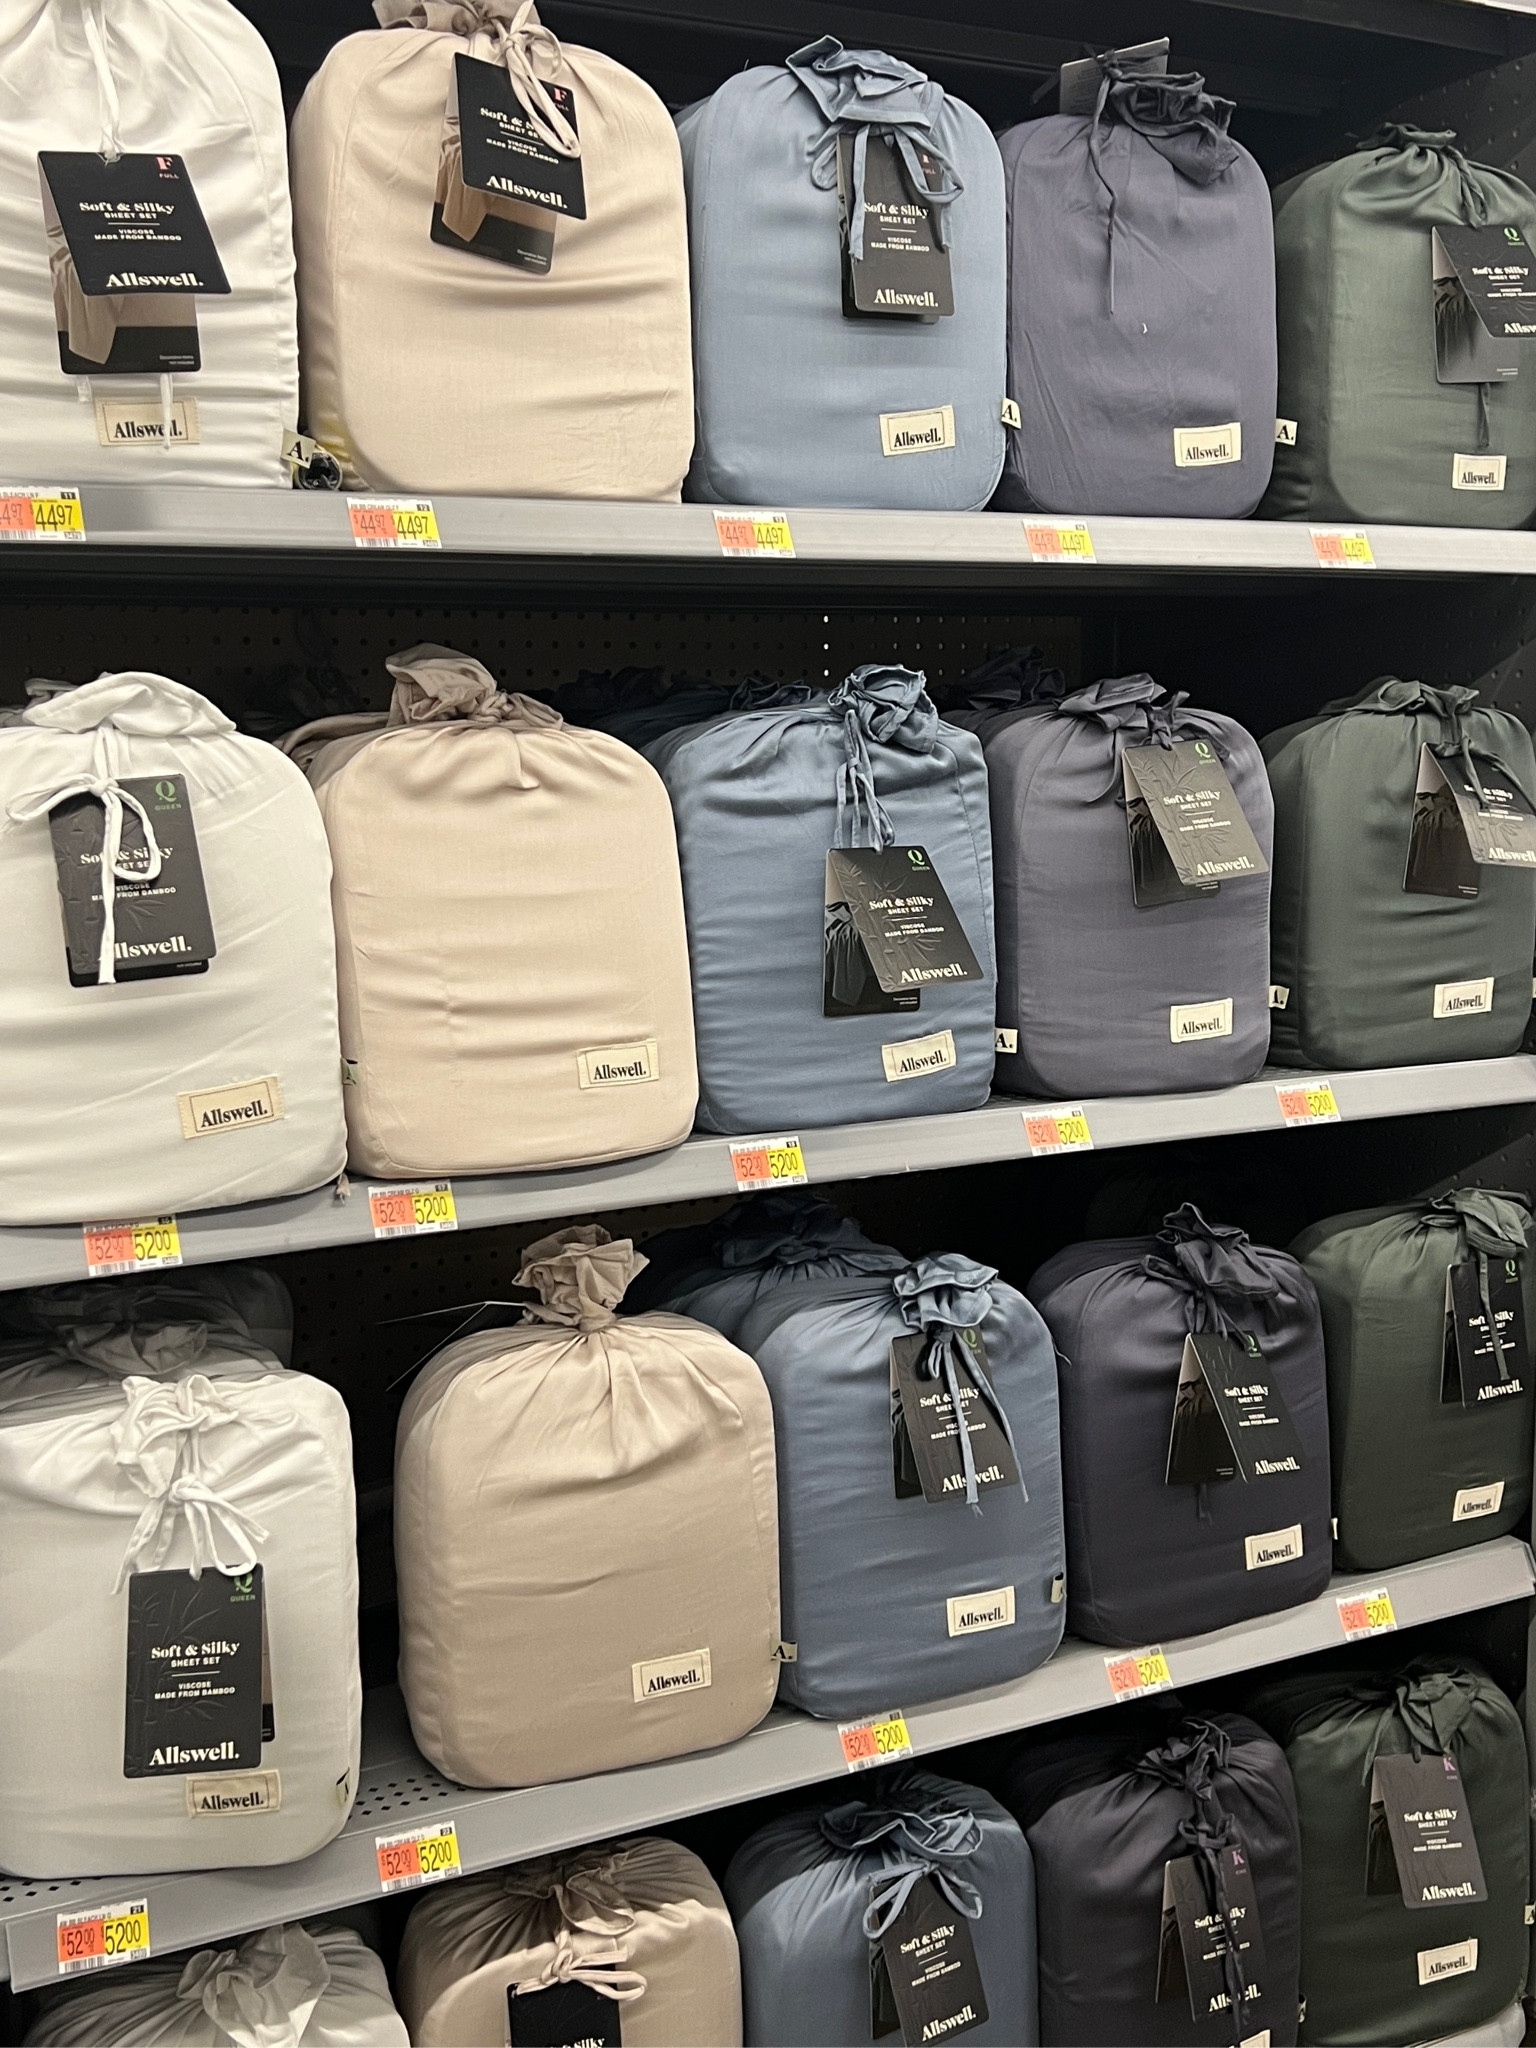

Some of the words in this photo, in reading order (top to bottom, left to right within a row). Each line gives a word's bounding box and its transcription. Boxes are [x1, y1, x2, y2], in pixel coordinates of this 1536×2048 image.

[554, 88, 567, 101] F
[480, 108, 508, 122] Soft
[511, 118, 522, 126] &
[499, 122, 525, 134] SHEET
[528, 130, 539, 138] SE
[487, 138, 506, 147] MADE
[508, 144, 527, 154] FROM
[529, 151, 559, 164] BAMBOO
[508, 140, 537, 151] VISCOSE
[156, 157, 173, 170] F
[487, 176, 567, 208] Allswell.
[80, 203, 113, 214] Soft
[117, 203, 131, 211] &
[134, 203, 174, 215] Silky
[864, 202, 886, 214] Soft
[889, 204, 898, 214] &
[901, 205, 928, 218] Silky
[1504, 227, 1519, 241] Q
[106, 273, 204, 287] Allswell.
[874, 289, 938, 307] Allswell.
[1002, 404, 1017, 422] A.
[114, 419, 182, 438] Allswel.
[1277, 425, 1294, 440] A.
[894, 428, 941, 447] Allswell.
[287, 442, 309, 462] A.
[1185, 444, 1229, 460] Allswell.
[1461, 472, 1496, 484] Allswell.
[1195, 742, 1211, 758] Q
[155, 780, 176, 802] Q
[1163, 795, 1183, 805] Soft
[1196, 790, 1221, 800] Silky
[907, 850, 925, 865] Q
[1197, 856, 1254, 876] Allswell.
[117, 890, 139, 898] FROM
[142, 887, 176, 895] BAMBOO
[869, 900, 892, 910] Soft
[895, 898, 904, 907] &
[906, 896, 934, 907] Silky
[888, 907, 909, 915] SHEET
[99, 936, 192, 961] llswell.
[900, 964, 967, 983] Allswell.
[1446, 995, 1483, 1011] Allswell.
[1181, 1018, 1222, 1034] Allswell.
[995, 1034, 1013, 1048] A.
[594, 1061, 646, 1080] Allswell.
[900, 1051, 946, 1073] Allswell.
[200, 1100, 268, 1128] Allswell.
[1505, 1259, 1516, 1276] Q
[962, 1329, 978, 1347] Q
[1478, 1379, 1523, 1400] Allswell.
[920, 1393, 940, 1407] Soft
[1255, 1457, 1300, 1475] Allswell.
[1257, 1544, 1294, 1563] Allswell.
[234, 1573, 253, 1593] Q
[959, 1607, 1003, 1627] Allswell.
[151, 1645, 181, 1659] Soft
[185, 1646, 198, 1656] &
[201, 1641, 240, 1655] Silky
[772, 1645, 793, 1660] A.
[171, 1658, 200, 1667] SHEET
[203, 1657, 220, 1665] SET
[178, 1681, 212, 1690] VISCOSE
[648, 1669, 700, 1693] Allswell.
[155, 1691, 176, 1700] MADE
[178, 1689, 200, 1697] FROM
[202, 1687, 235, 1696] BAMBOO
[149, 1742, 240, 1766] Allswell.
[1443, 1757, 1456, 1771] K
[200, 1792, 264, 1811] Allswell.
[1404, 1810, 1423, 1822] Soft
[1425, 1810, 1433, 1820] &
[1434, 1809, 1458, 1821] Silky
[1232, 1850, 1244, 1866] K
[1422, 1882, 1476, 1901] Allswell.
[900, 1938, 920, 1954] Soft
[921, 1935, 931, 1945] &
[931, 1925, 955, 1942] Silky
[1428, 1955, 1468, 1976] Allswell.
[922, 2005, 976, 2041] Allswell.
